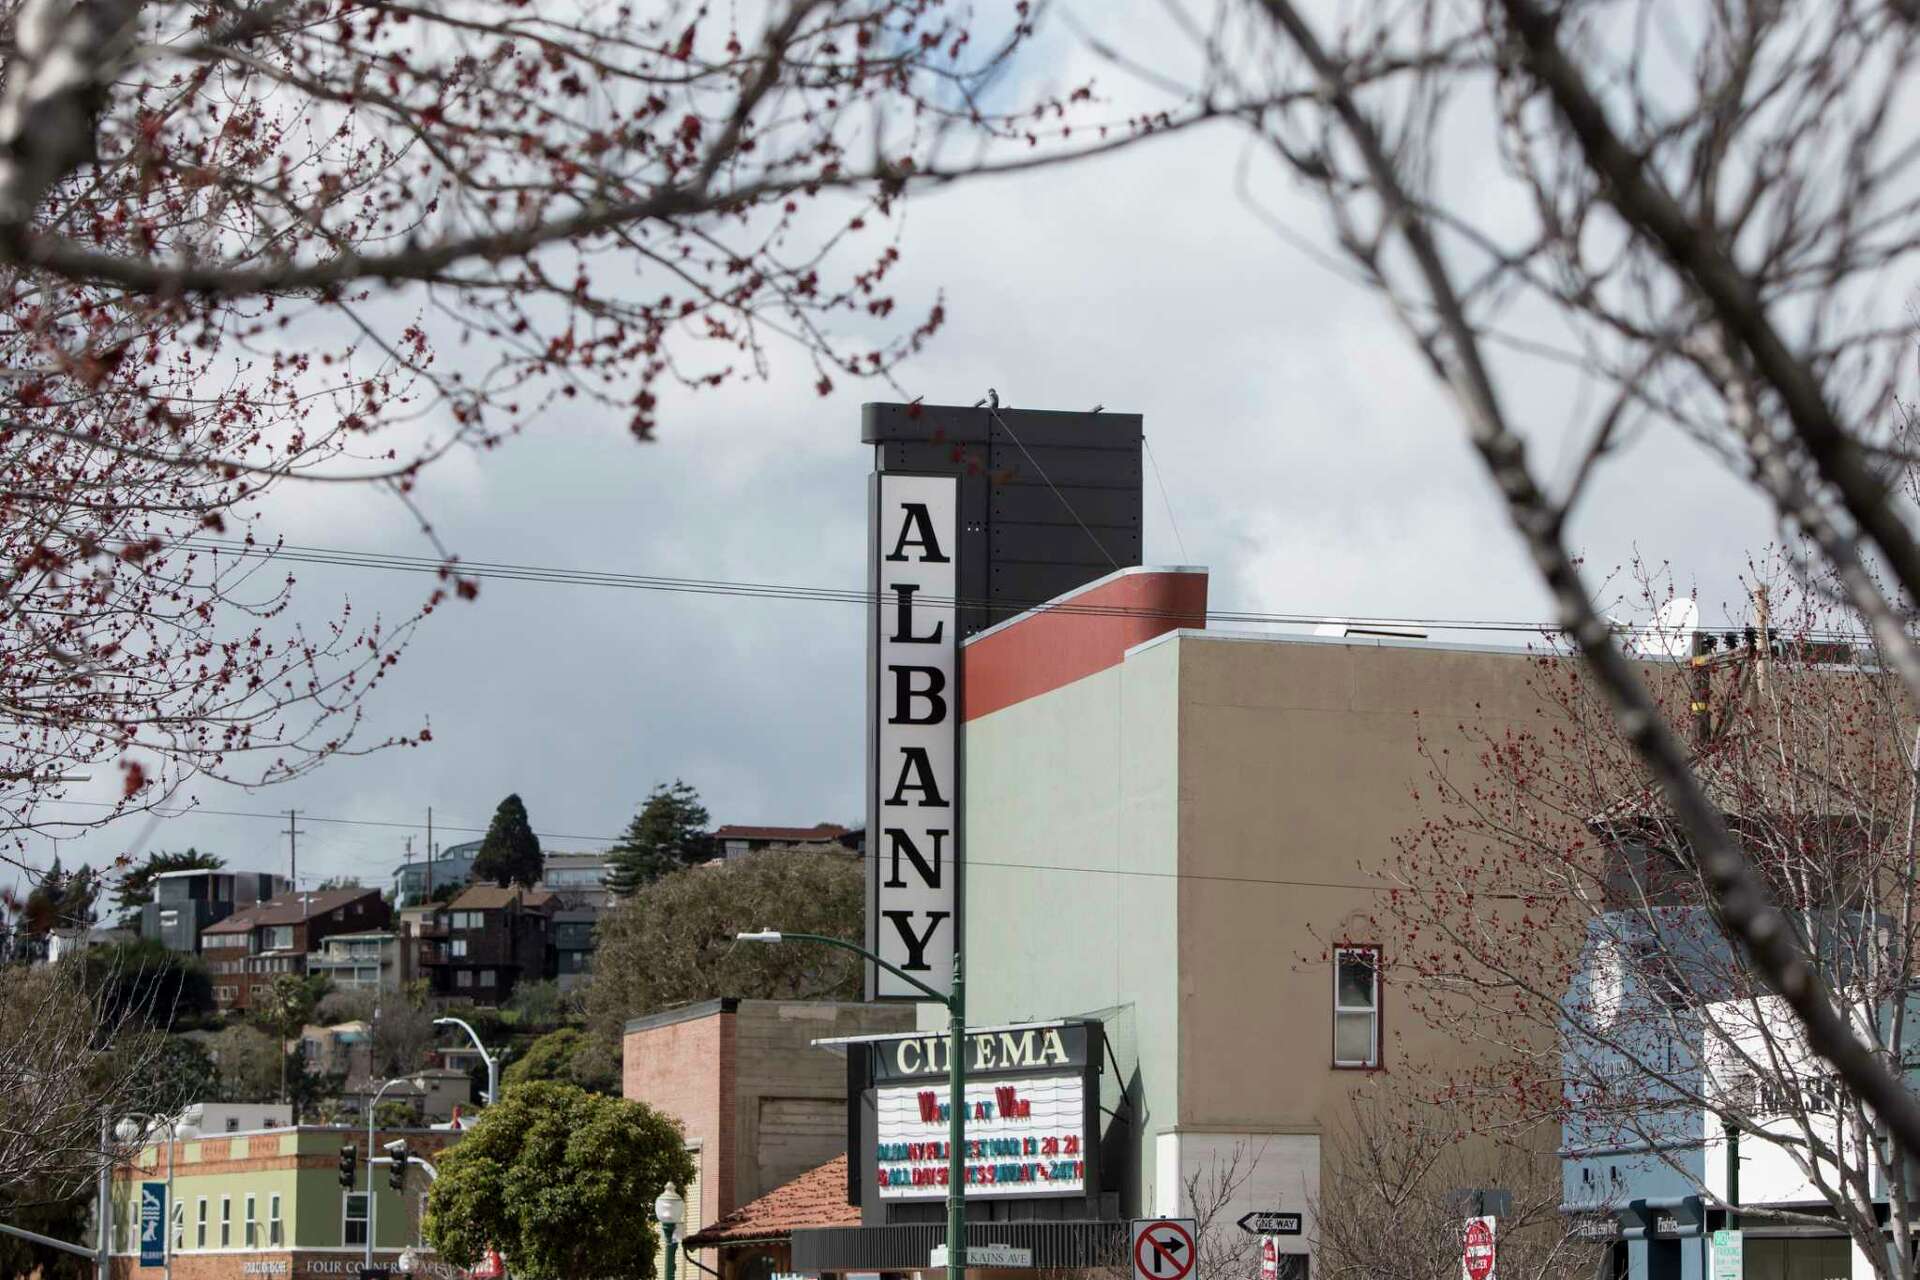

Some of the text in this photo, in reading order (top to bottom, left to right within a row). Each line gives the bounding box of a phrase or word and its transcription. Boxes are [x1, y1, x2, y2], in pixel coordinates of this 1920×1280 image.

[882, 502, 951, 970] ALBANY
[1041, 1135, 1058, 1154] 20
[1255, 1218, 1295, 1229] ONE WAY
[970, 1251, 1028, 1264] KAINS AVE
[306, 1260, 342, 1273] FOUR
